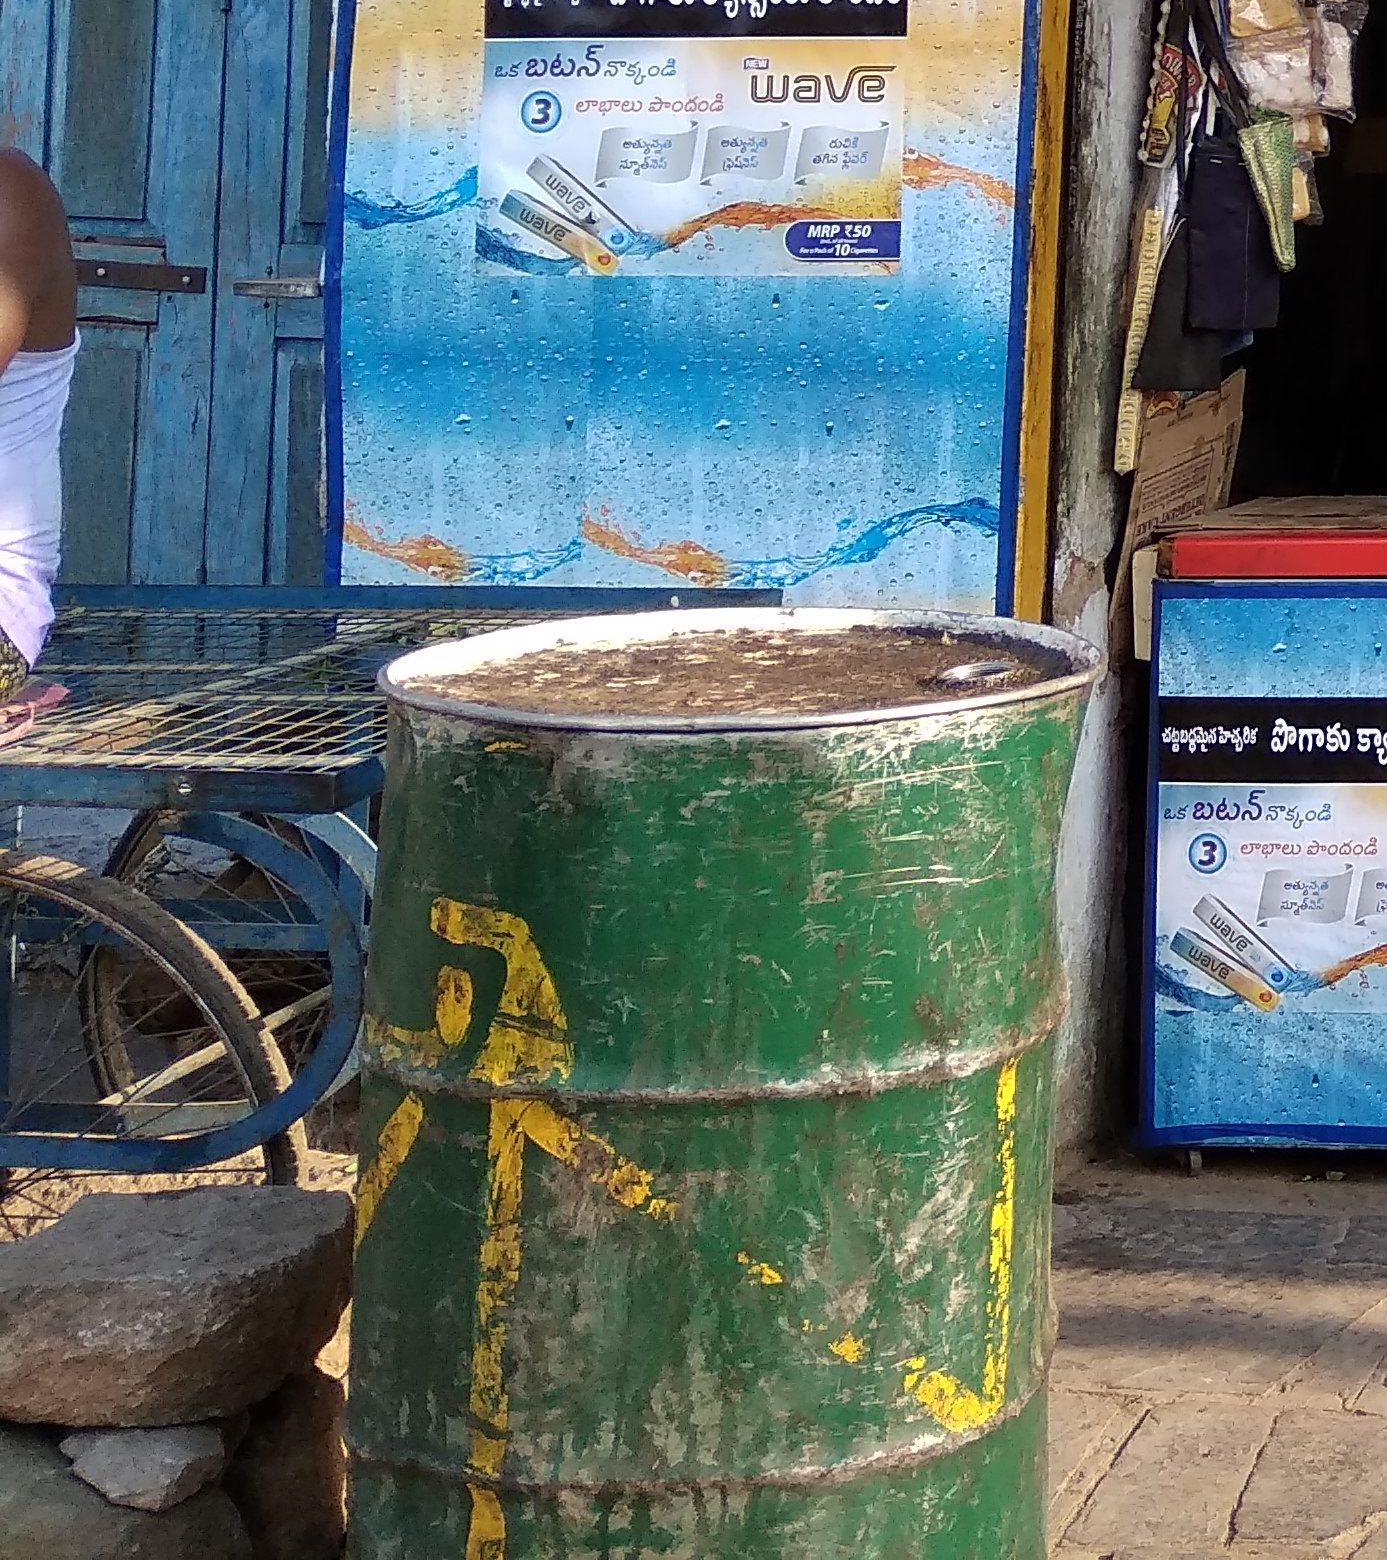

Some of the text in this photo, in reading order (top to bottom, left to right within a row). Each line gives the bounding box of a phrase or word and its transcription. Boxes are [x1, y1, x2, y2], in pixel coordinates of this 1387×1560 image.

[494, 61, 522, 79] ఒక
[524, 44, 604, 79] బటన్
[744, 57, 770, 71] NEW
[749, 65, 897, 104] wave
[531, 97, 553, 126] 3
[545, 174, 592, 214] wave
[519, 208, 572, 242] wave
[806, 224, 873, 238] MRP ₹50
[834, 243, 851, 256] 10
[1163, 806, 1190, 822] ఒక
[1191, 790, 1266, 822] బటన్
[1196, 840, 1219, 867] 3
[1209, 913, 1253, 953] wave
[1187, 945, 1236, 981] wave
